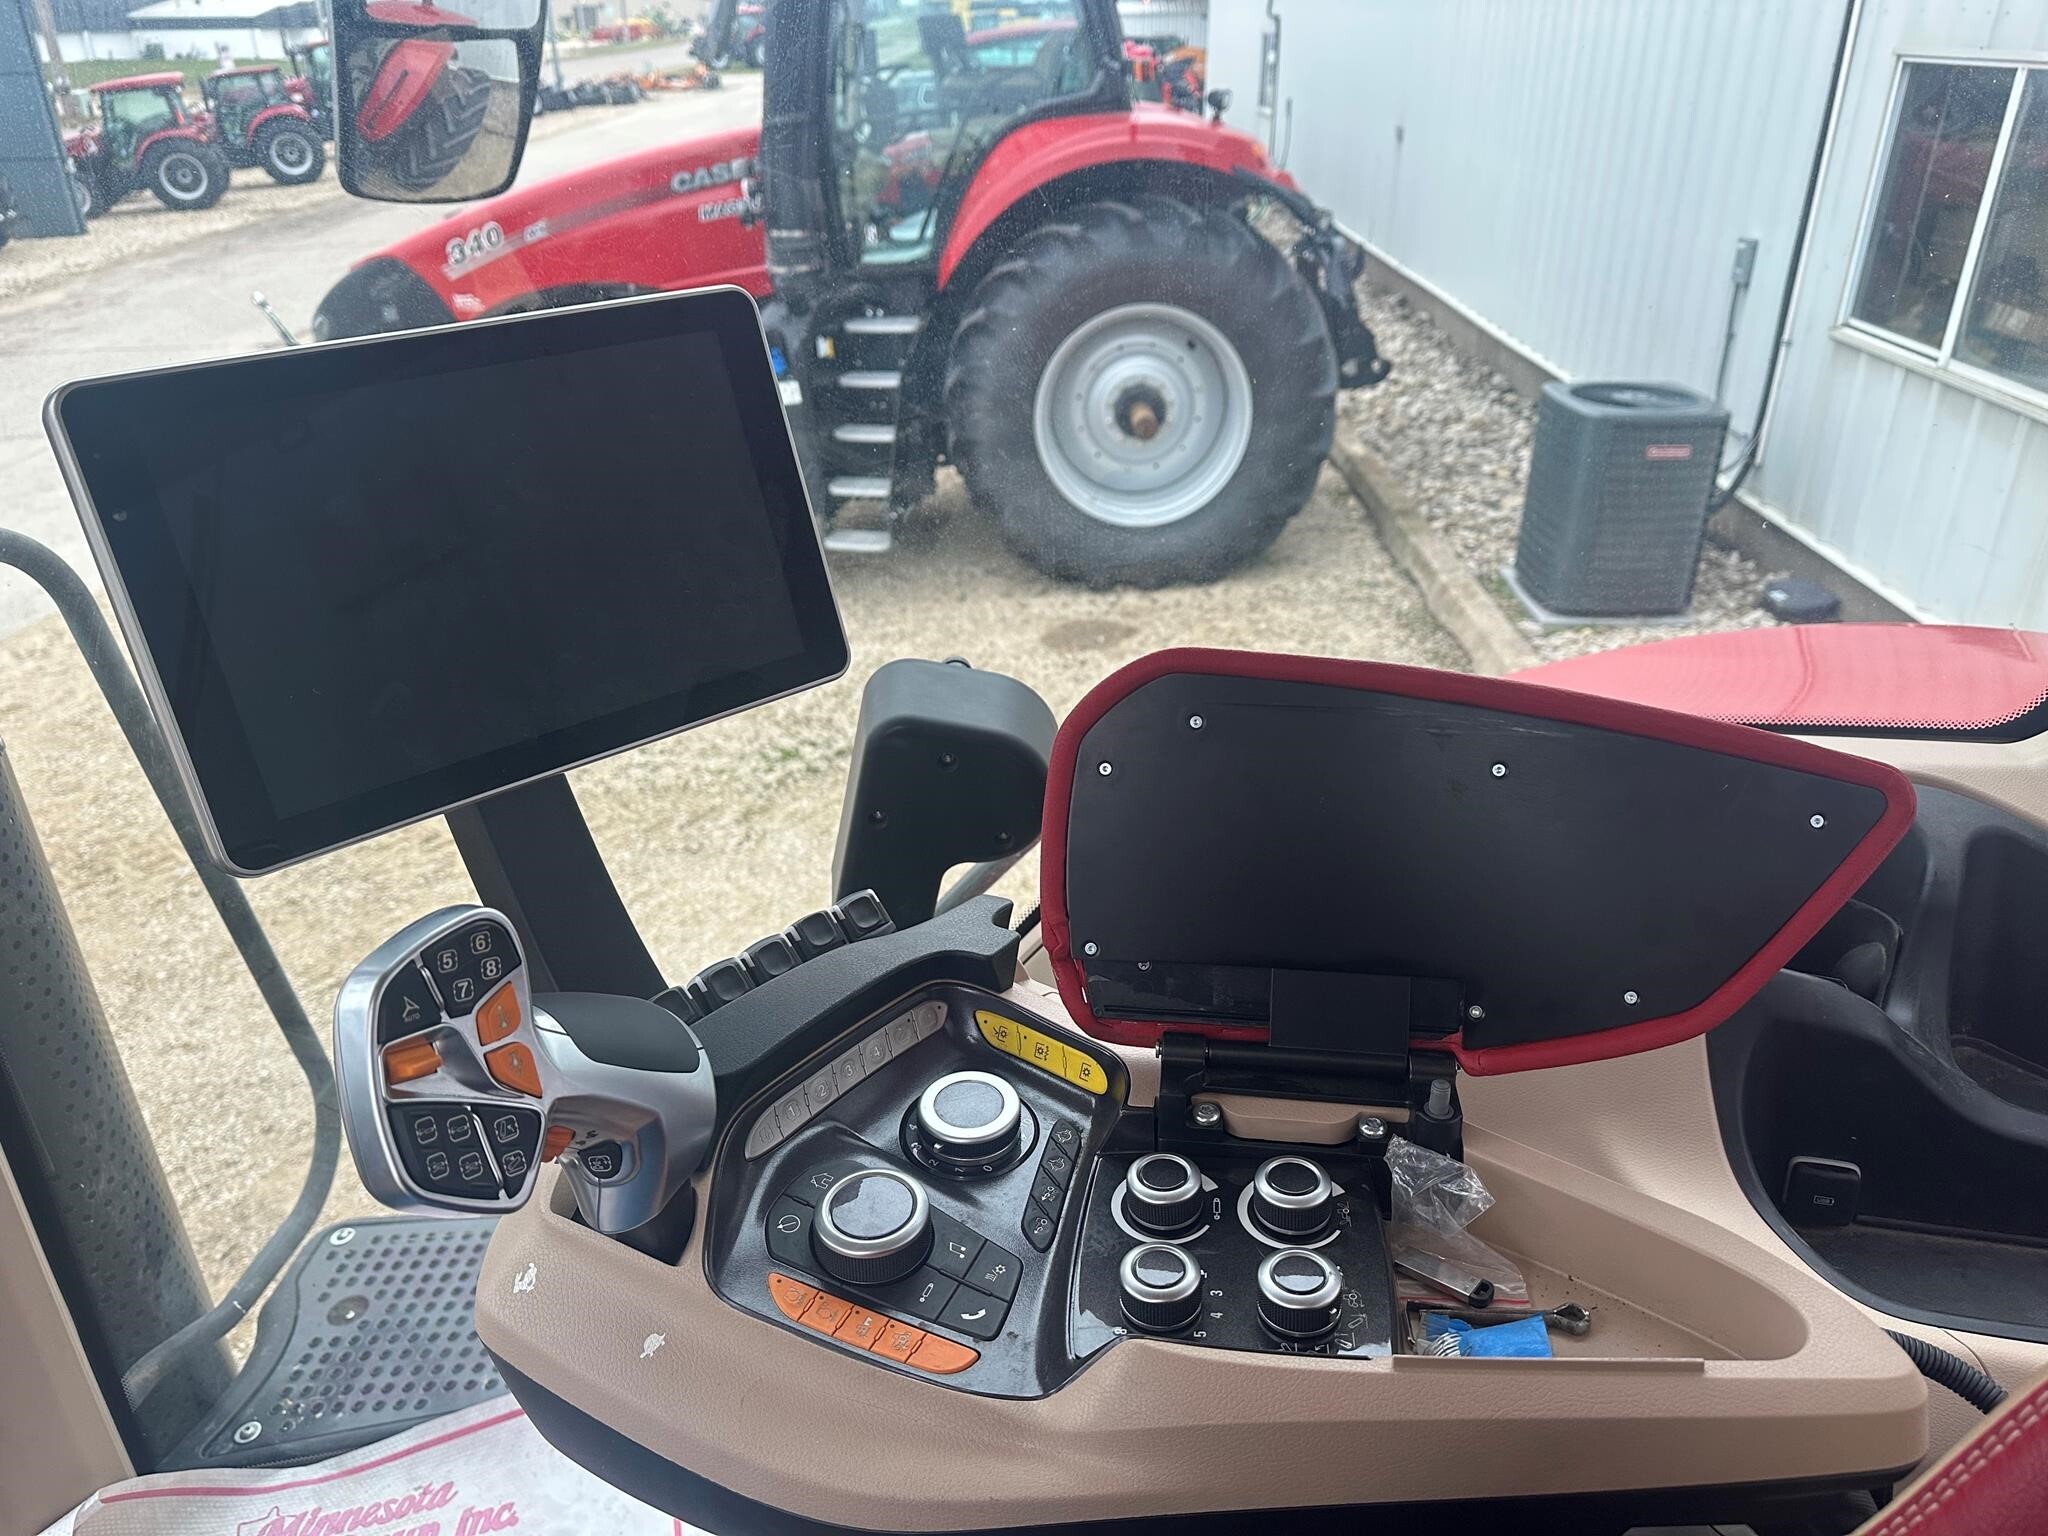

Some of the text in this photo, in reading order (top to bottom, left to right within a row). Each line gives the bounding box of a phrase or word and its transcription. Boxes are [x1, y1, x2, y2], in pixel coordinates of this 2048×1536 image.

[446, 222, 504, 264] 340
[475, 935, 486, 950] 6
[443, 953, 453, 969] 5
[486, 960, 496, 976] 8
[458, 982, 468, 998] 7
[404, 1013, 421, 1022] AUTO
[845, 1065, 853, 1076] 3
[819, 1085, 828, 1097] 2
[788, 1106, 796, 1117] 1
[909, 1123, 918, 1131] 4
[928, 1159, 939, 1167] 2
[1113, 1326, 1128, 1335] 8
[1194, 1330, 1207, 1338] 5
[256, 1481, 458, 1536] Minnesota
[455, 1502, 519, 1536] Inc.
